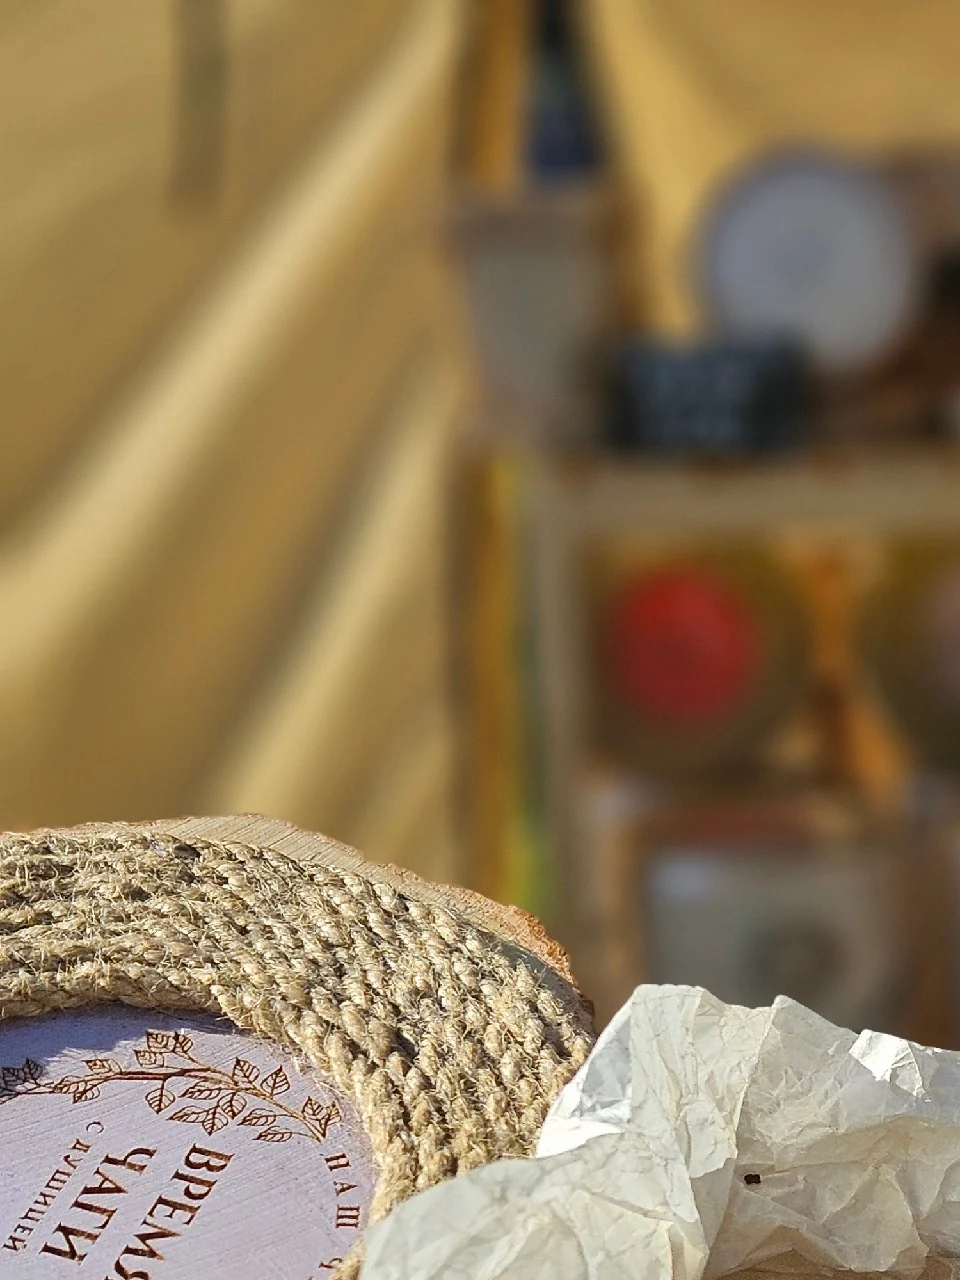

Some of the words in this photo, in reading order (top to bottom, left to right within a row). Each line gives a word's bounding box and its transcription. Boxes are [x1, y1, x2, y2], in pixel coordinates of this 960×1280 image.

[86, 1121, 104, 1134] С
[2, 1138, 93, 1251] ДУШИЦЕЙ
[39, 1146, 158, 1265] ЧАГИ
[324, 1153, 361, 1229] НАШ
